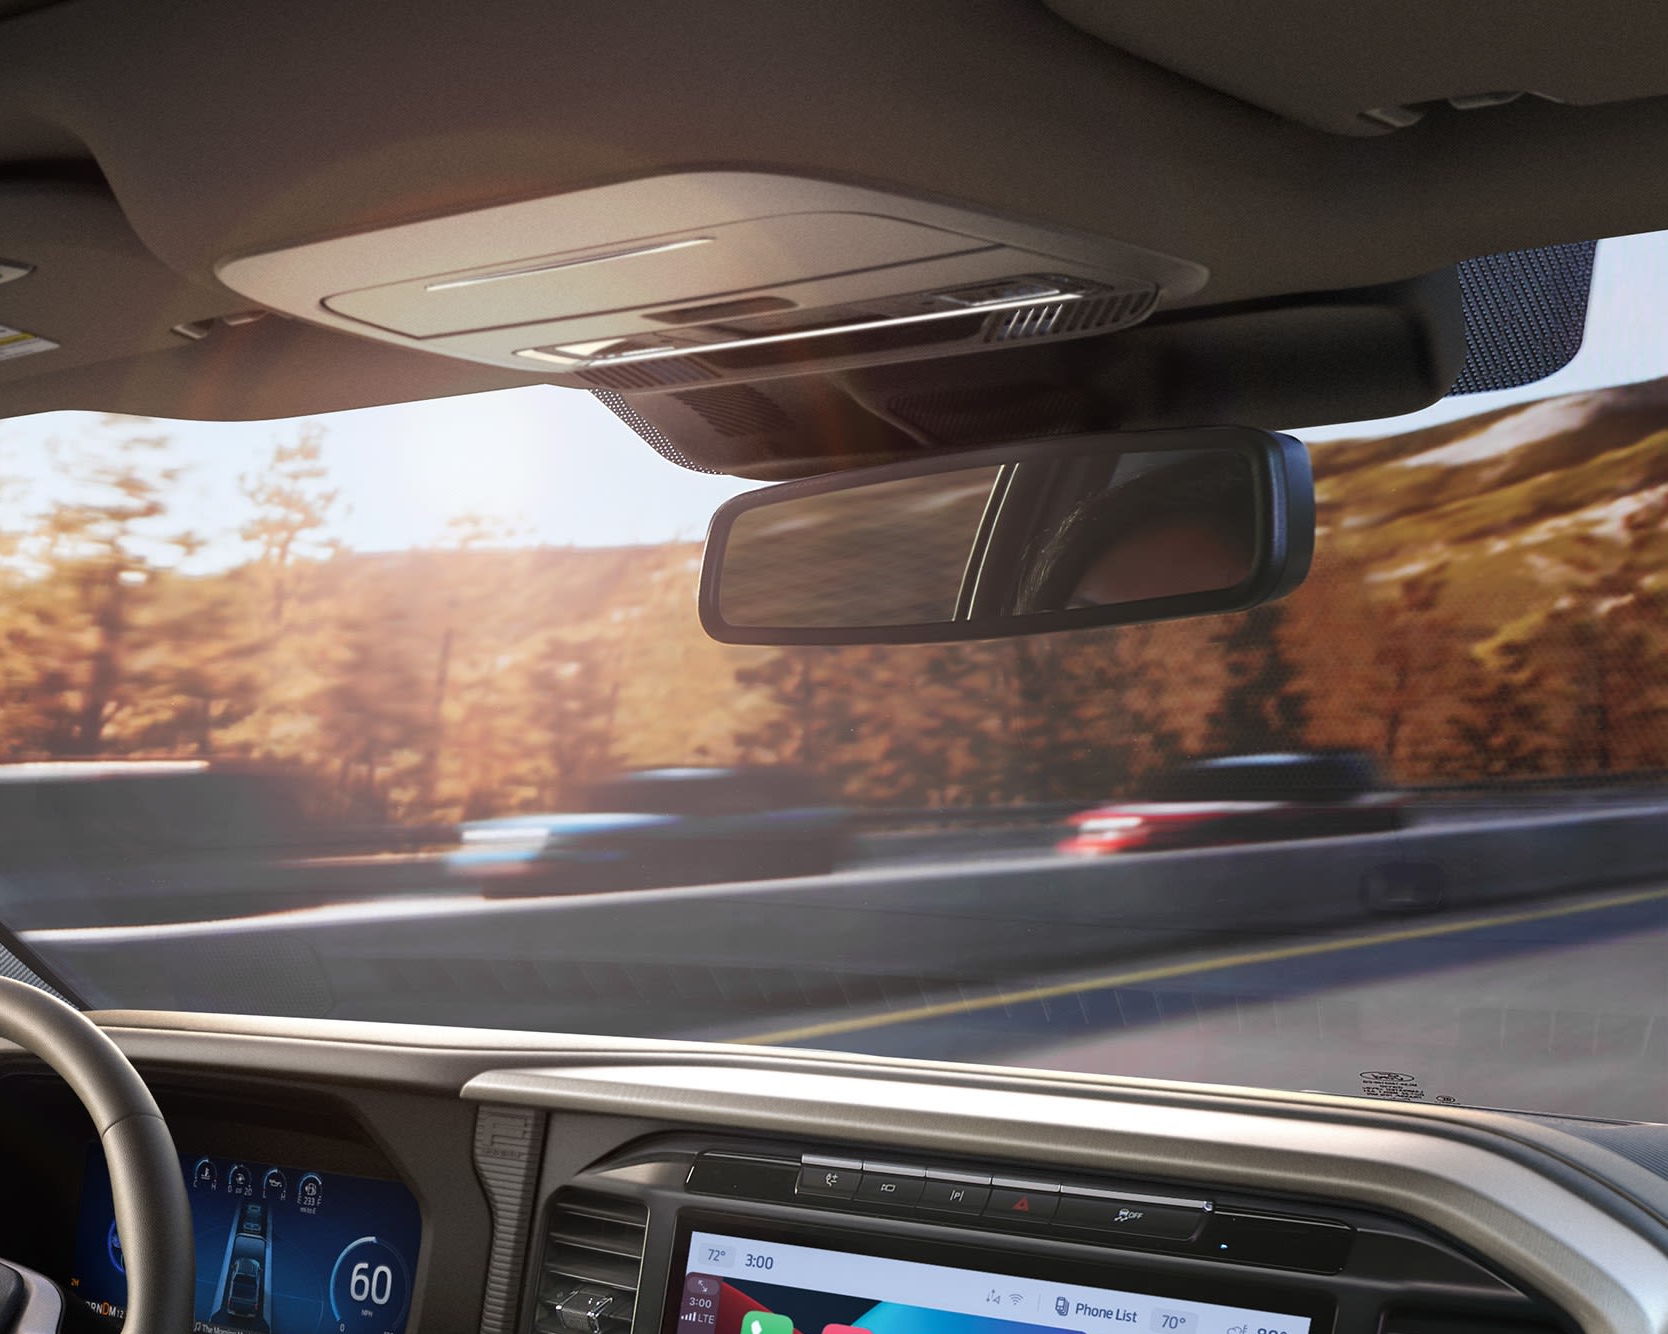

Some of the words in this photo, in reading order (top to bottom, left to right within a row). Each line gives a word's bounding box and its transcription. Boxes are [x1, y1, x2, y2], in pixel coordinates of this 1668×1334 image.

[1128, 1211, 1144, 1220] OFF
[707, 1248, 726, 1262] 72°
[744, 1253, 774, 1270] 3:00
[349, 1262, 393, 1305] 60
[688, 1296, 712, 1309] 3:00
[697, 1312, 715, 1325] LTE
[1075, 1302, 1113, 1321] Phone
[1115, 1307, 1137, 1323] List
[202, 1323, 213, 1334] The
[339, 1323, 345, 1332] 0
[1160, 1314, 1186, 1330] 70°
